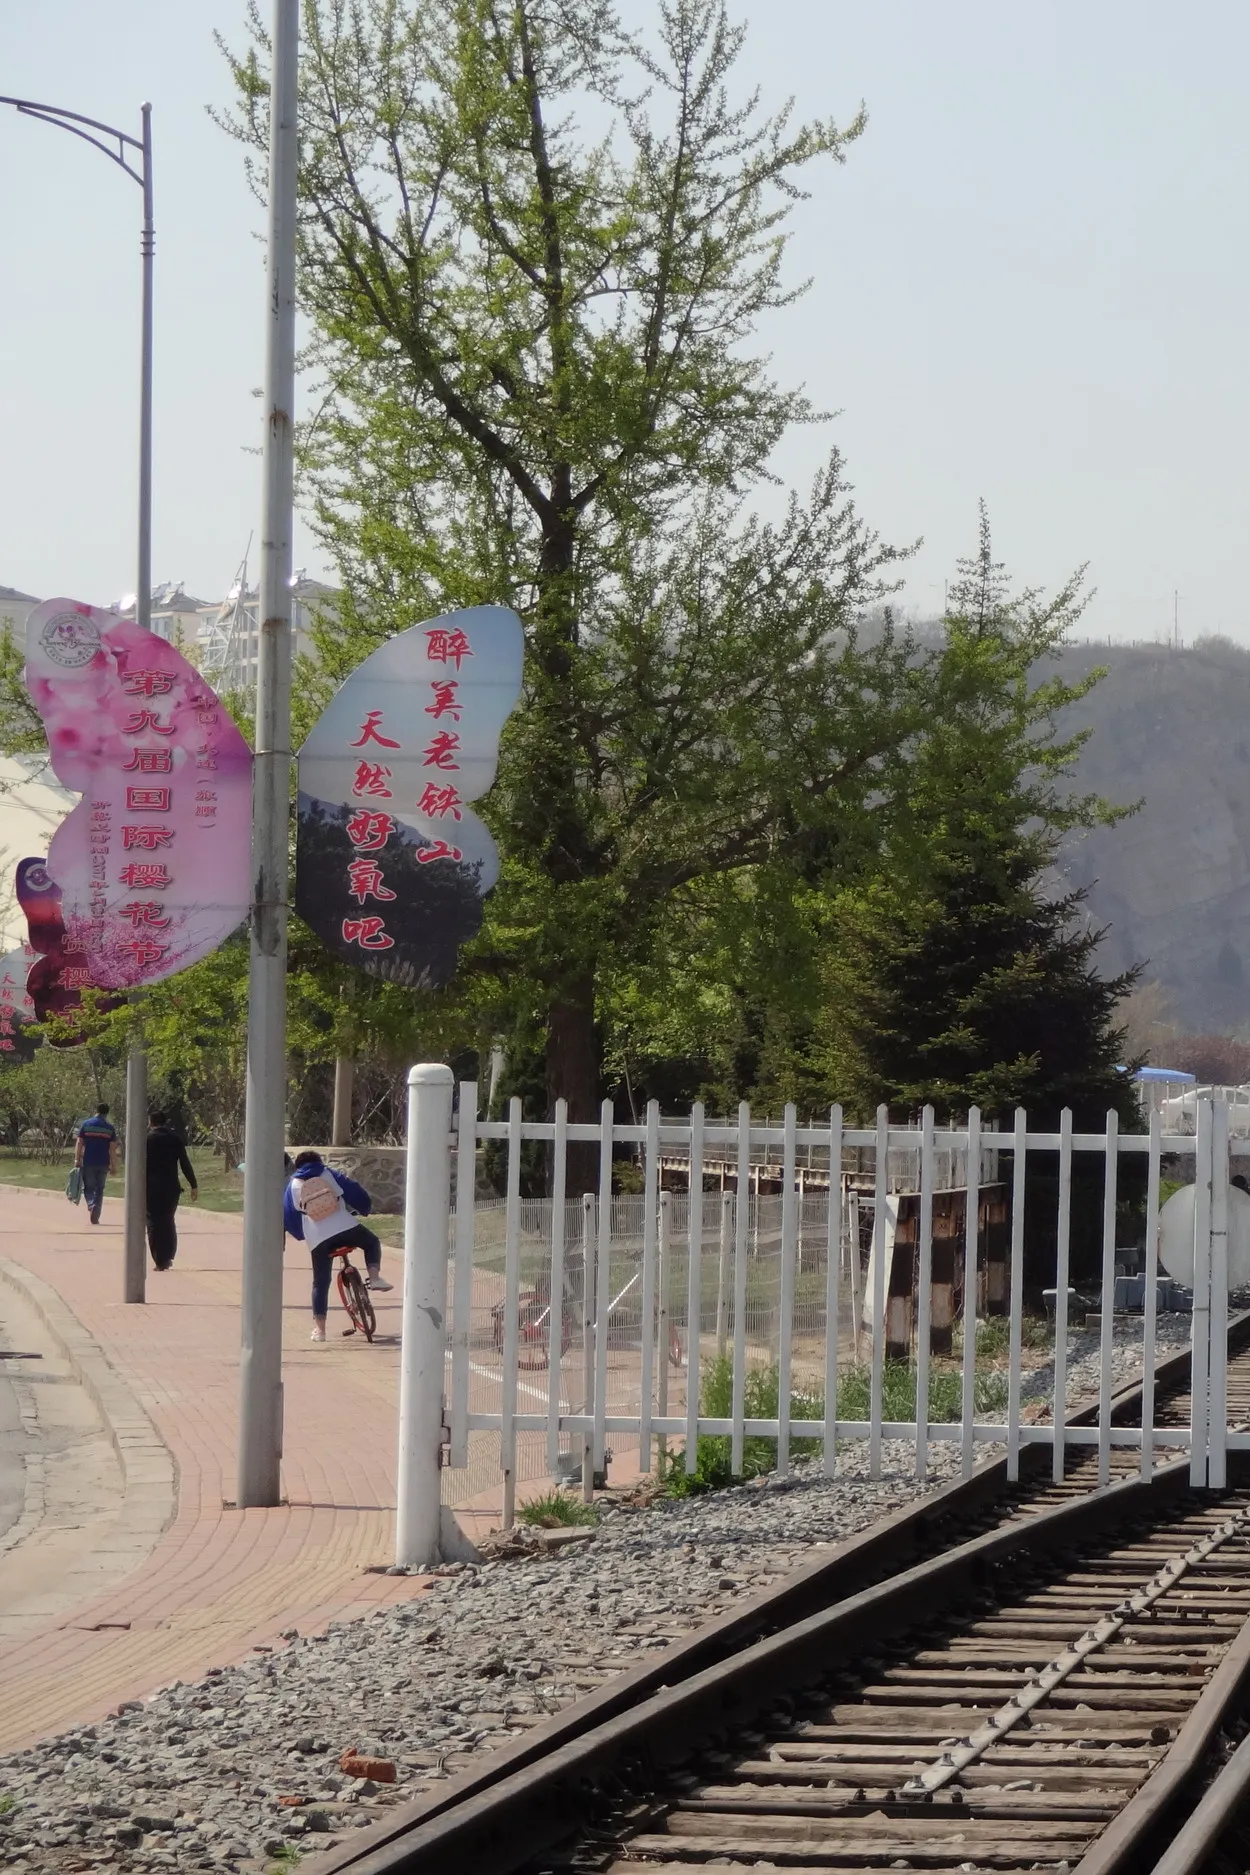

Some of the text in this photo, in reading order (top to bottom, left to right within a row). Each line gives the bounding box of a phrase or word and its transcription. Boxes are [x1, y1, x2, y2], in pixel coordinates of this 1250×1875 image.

[117, 668, 176, 966] 第九届国际樱花节
[341, 710, 401, 950] 天然好氧吧
[415, 628, 475, 864] 醉美老铁山
